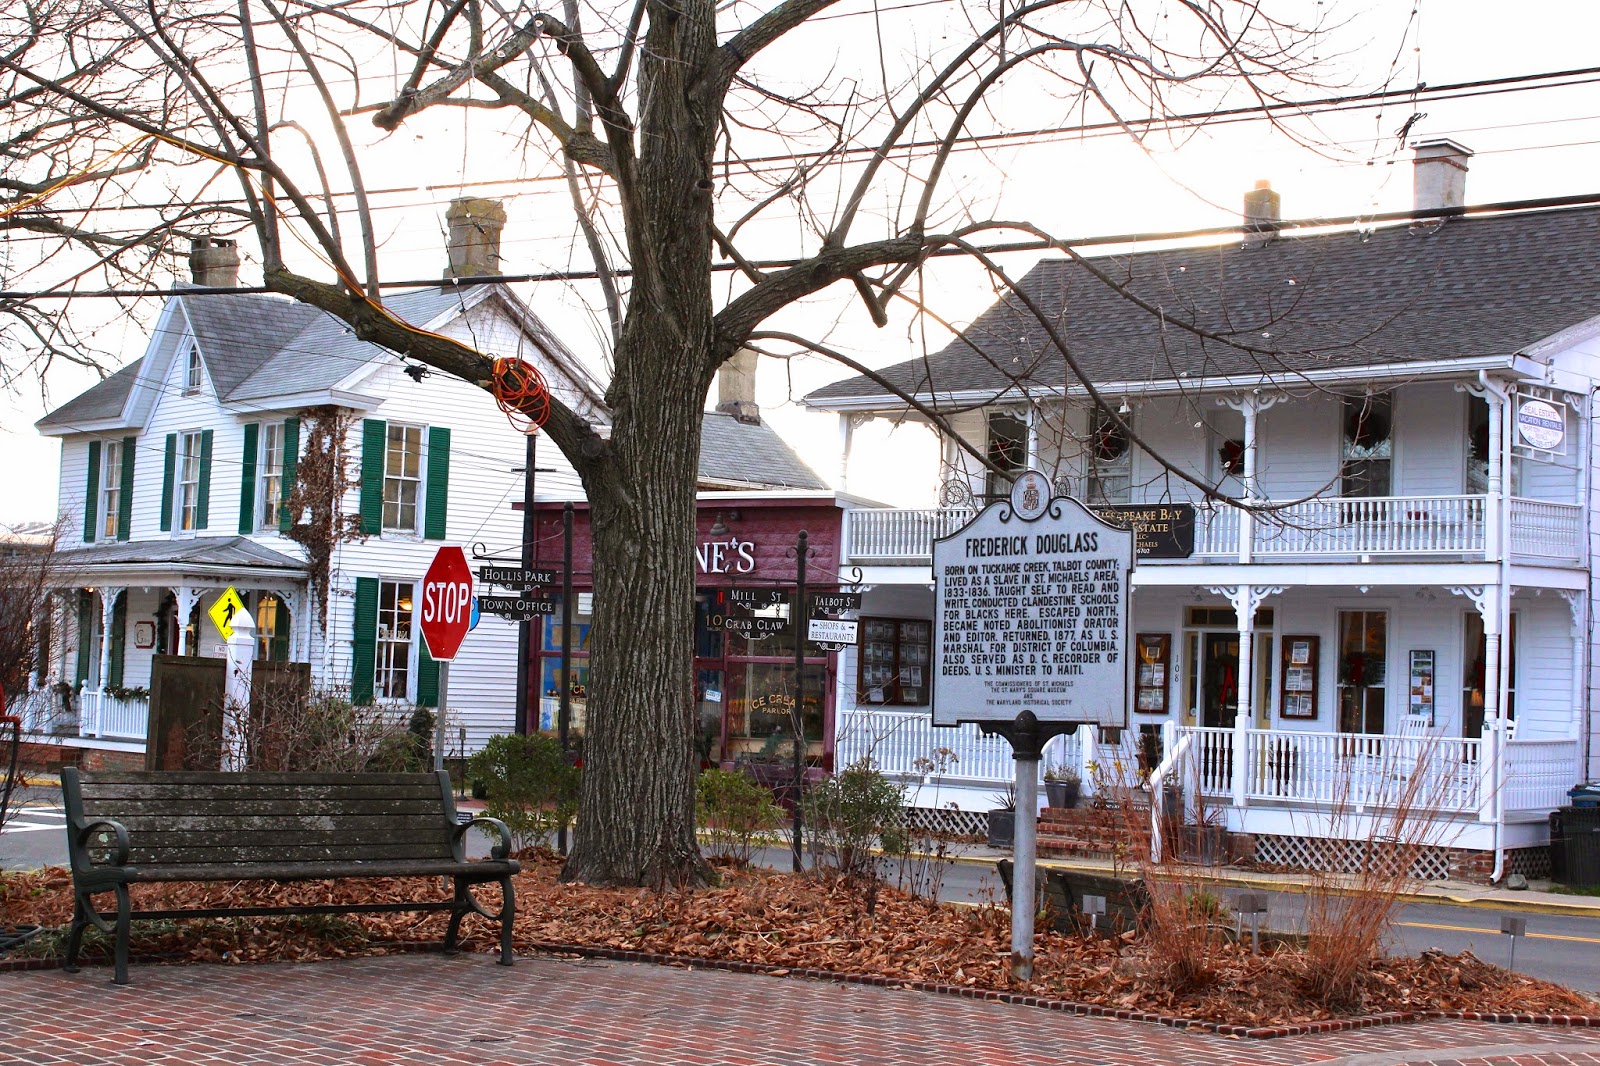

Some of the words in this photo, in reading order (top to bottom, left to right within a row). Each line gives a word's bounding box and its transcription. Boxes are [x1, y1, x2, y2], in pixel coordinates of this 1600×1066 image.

[1524, 405, 1538, 416] REAL
[1539, 409, 1556, 420] ESTATE
[1519, 415, 1540, 425] VACATION
[1542, 420, 1562, 431] RENTALS
[1160, 509, 1182, 520] BAY
[966, 536, 1028, 558] FREDERICK
[1036, 532, 1098, 554] DOUGLASS
[945, 566, 964, 575] BORN
[968, 565, 978, 574] ON
[982, 563, 1020, 574] TUCKAHOE
[1052, 560, 1082, 571] TALBOT
[484, 568, 521, 581] HOLLIS
[525, 571, 551, 583] PARK
[944, 576, 967, 586] LIVED
[971, 576, 981, 586] AS
[984, 576, 990, 585] A
[994, 575, 1018, 585] SLAVE
[1022, 574, 1030, 584] IN
[1034, 574, 1046, 584] ST.
[1048, 572, 1089, 583] MICHAELS
[731, 590, 756, 600] MILL
[771, 591, 782, 602] ST
[944, 587, 990, 598] 1833-1836.
[995, 586, 1026, 596] TAUGHT
[1031, 585, 1051, 595] SELF
[1057, 584, 1066, 594] TO
[1072, 583, 1095, 594] READ
[1101, 582, 1119, 592] AND
[424, 582, 469, 623] STOP
[481, 599, 513, 610] TOWN
[516, 600, 552, 612] OFFICE
[815, 596, 843, 607] TALBOT
[846, 597, 854, 607] ST
[972, 598, 1018, 608] CONDUCTED
[1022, 595, 1076, 606] CLANDESTINE
[1080, 594, 1119, 605] SCHOOLS
[944, 610, 960, 620] FOR
[966, 609, 999, 619] BLACKS
[1005, 608, 1030, 618] HERE.
[1039, 607, 1080, 617] ESCAPED
[725, 619, 752, 630] CRAB
[757, 620, 784, 630] CLAW
[819, 622, 838, 630] SHOPS
[840, 622, 846, 630] &
[944, 621, 977, 631] BECAME
[984, 620, 1010, 630] NOTED
[1017, 618, 1077, 629] ABOLITIONIST
[1084, 618, 1119, 628] ORATOR
[811, 631, 854, 641] RESTAURANTS
[944, 633, 960, 642] AND
[966, 632, 998, 642] EDITOR.
[1081, 630, 1092, 640] AS
[1099, 630, 1107, 639] U.
[1111, 630, 1119, 639] S.
[943, 644, 984, 653] MARSHAL
[990, 643, 1006, 653] FOR
[1013, 642, 1051, 652] DISTRICT
[1056, 642, 1066, 651] OF
[943, 654, 965, 664] ALSO
[971, 654, 1006, 664] SERVED
[1013, 654, 1024, 664] AS
[1030, 654, 1037, 664] D.
[1042, 654, 1049, 663] C.
[1053, 653, 1100, 663] RECORDER
[1107, 653, 1118, 662] OF
[976, 665, 982, 675] U.
[985, 665, 992, 675] S.
[996, 665, 1036, 675] MINISTER
[1042, 665, 1052, 675] TO
[1058, 665, 1084, 675] HAITI.
[750, 697, 766, 712] ICE
